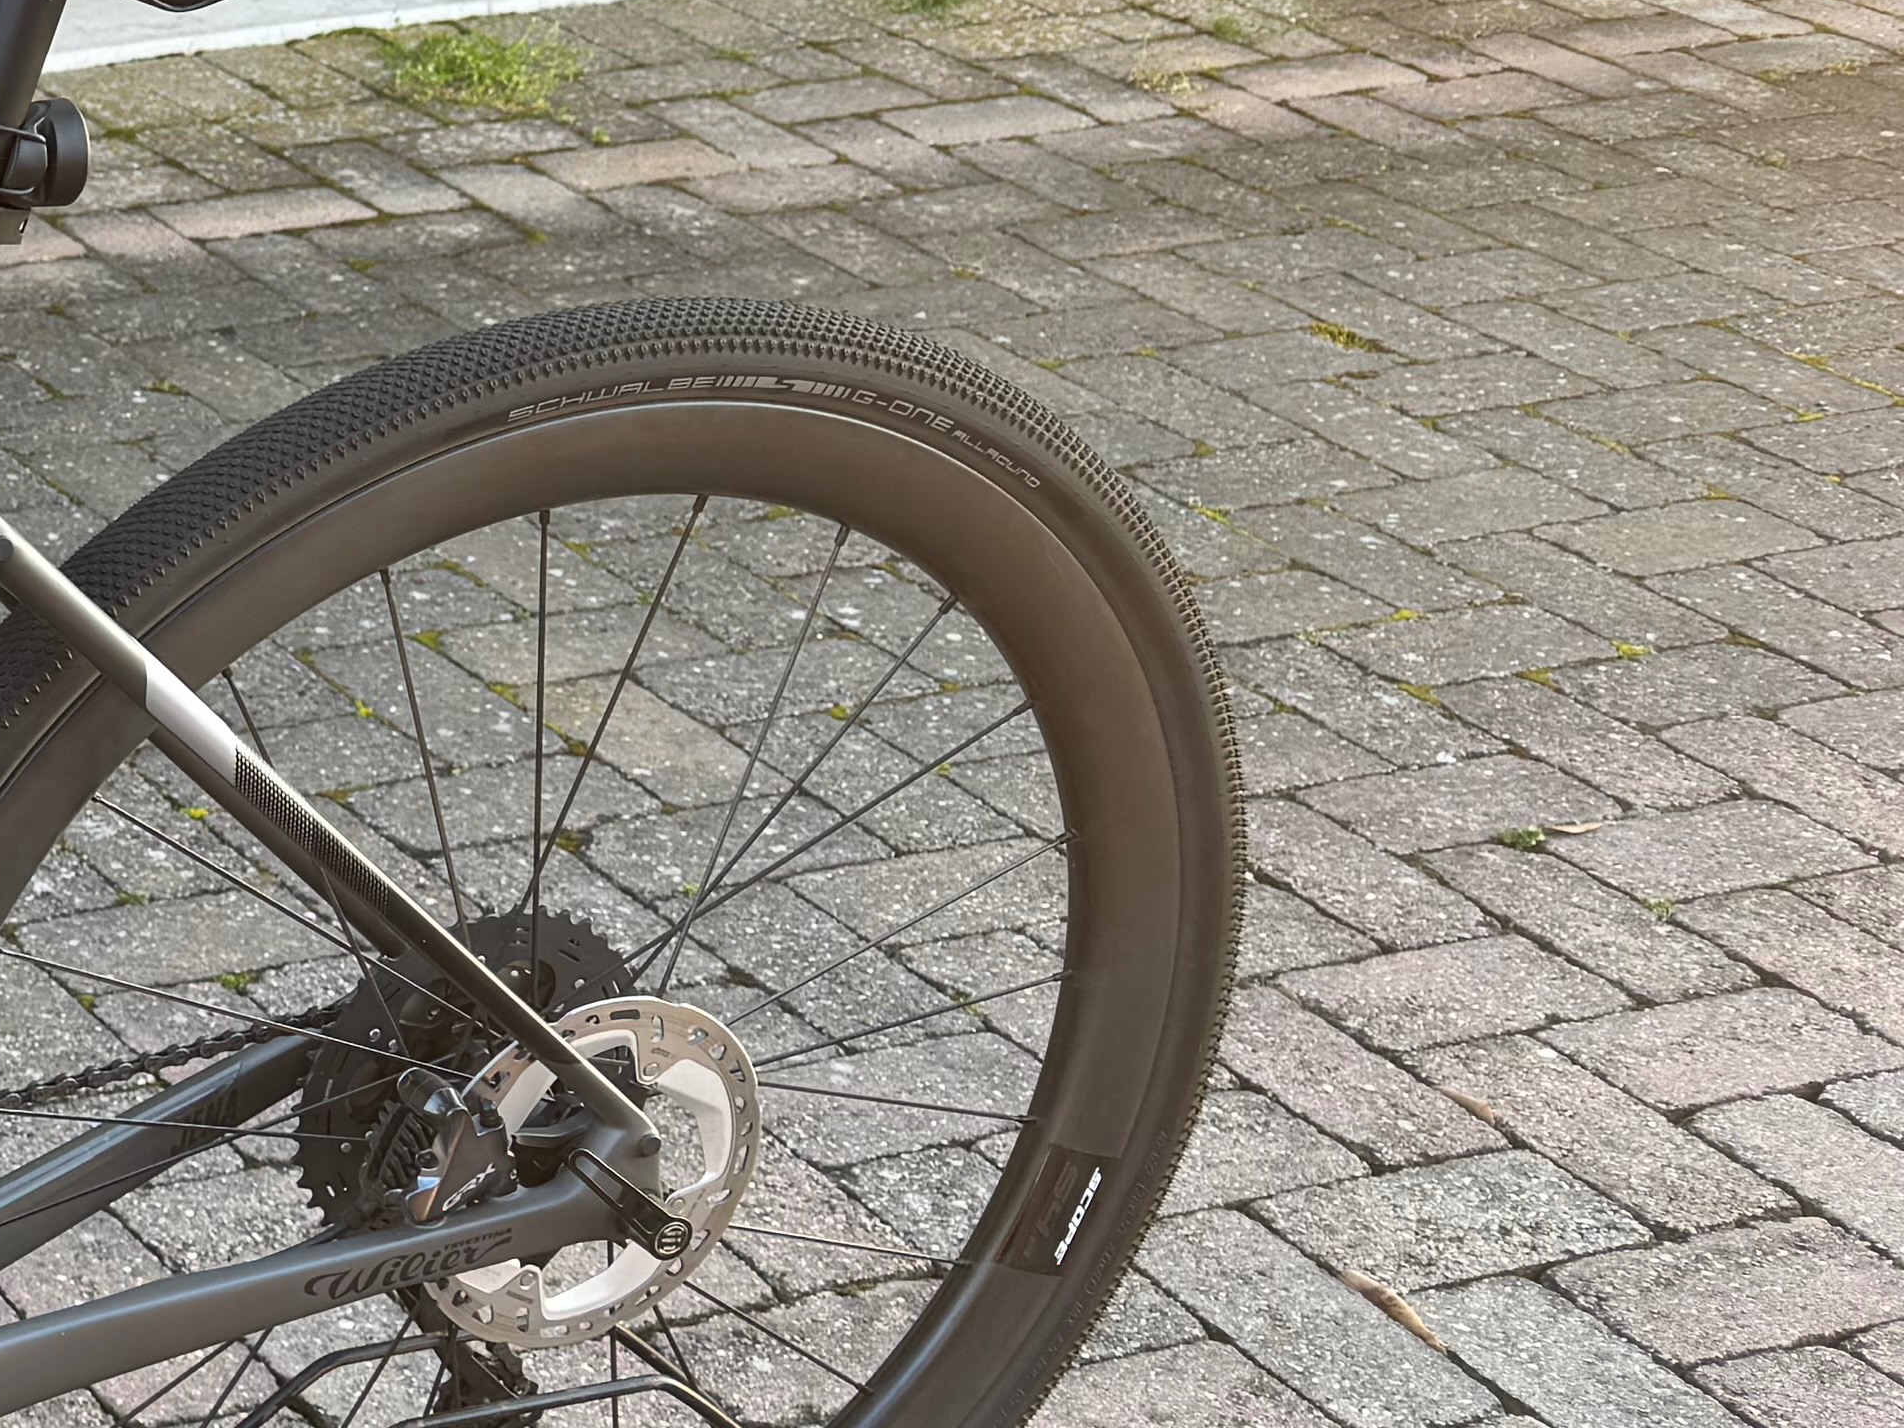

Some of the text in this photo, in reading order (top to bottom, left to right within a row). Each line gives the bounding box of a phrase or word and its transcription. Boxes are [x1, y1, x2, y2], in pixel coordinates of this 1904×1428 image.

[507, 376, 1041, 488] SCHWALBE G-ONE ALLROUND
[444, 1227, 513, 1251] TRIESTINA
[1054, 1166, 1102, 1266] SCOPE
[303, 1235, 513, 1301] Wilier
